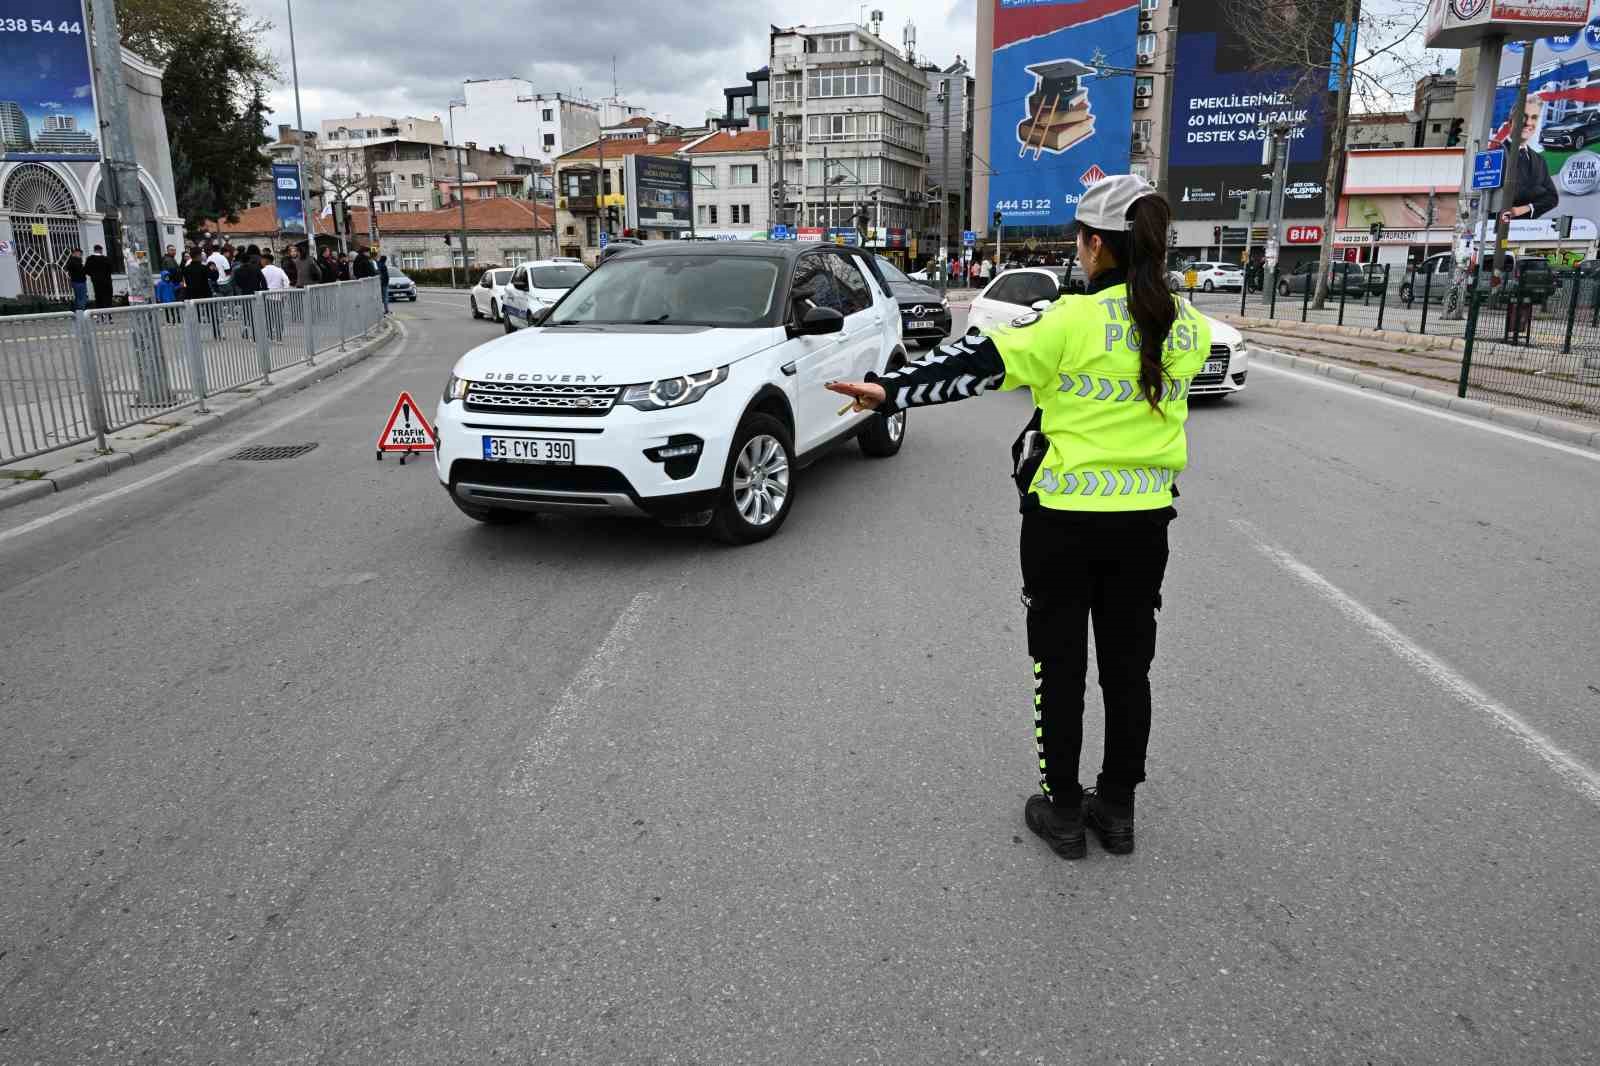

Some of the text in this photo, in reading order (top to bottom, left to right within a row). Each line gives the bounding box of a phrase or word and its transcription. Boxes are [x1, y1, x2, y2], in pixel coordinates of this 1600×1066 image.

[32, 20, 54, 33] 54
[58, 21, 81, 35] 44
[1188, 115, 1205, 126] 60
[1207, 112, 1256, 125] MİLYON
[1187, 130, 1235, 143] DESTEK
[996, 199, 1051, 210] 444 51 22
[1290, 228, 1318, 240] BİM
[485, 372, 603, 383] DISCOVERY
[491, 440, 571, 460] 35 CYG 390
